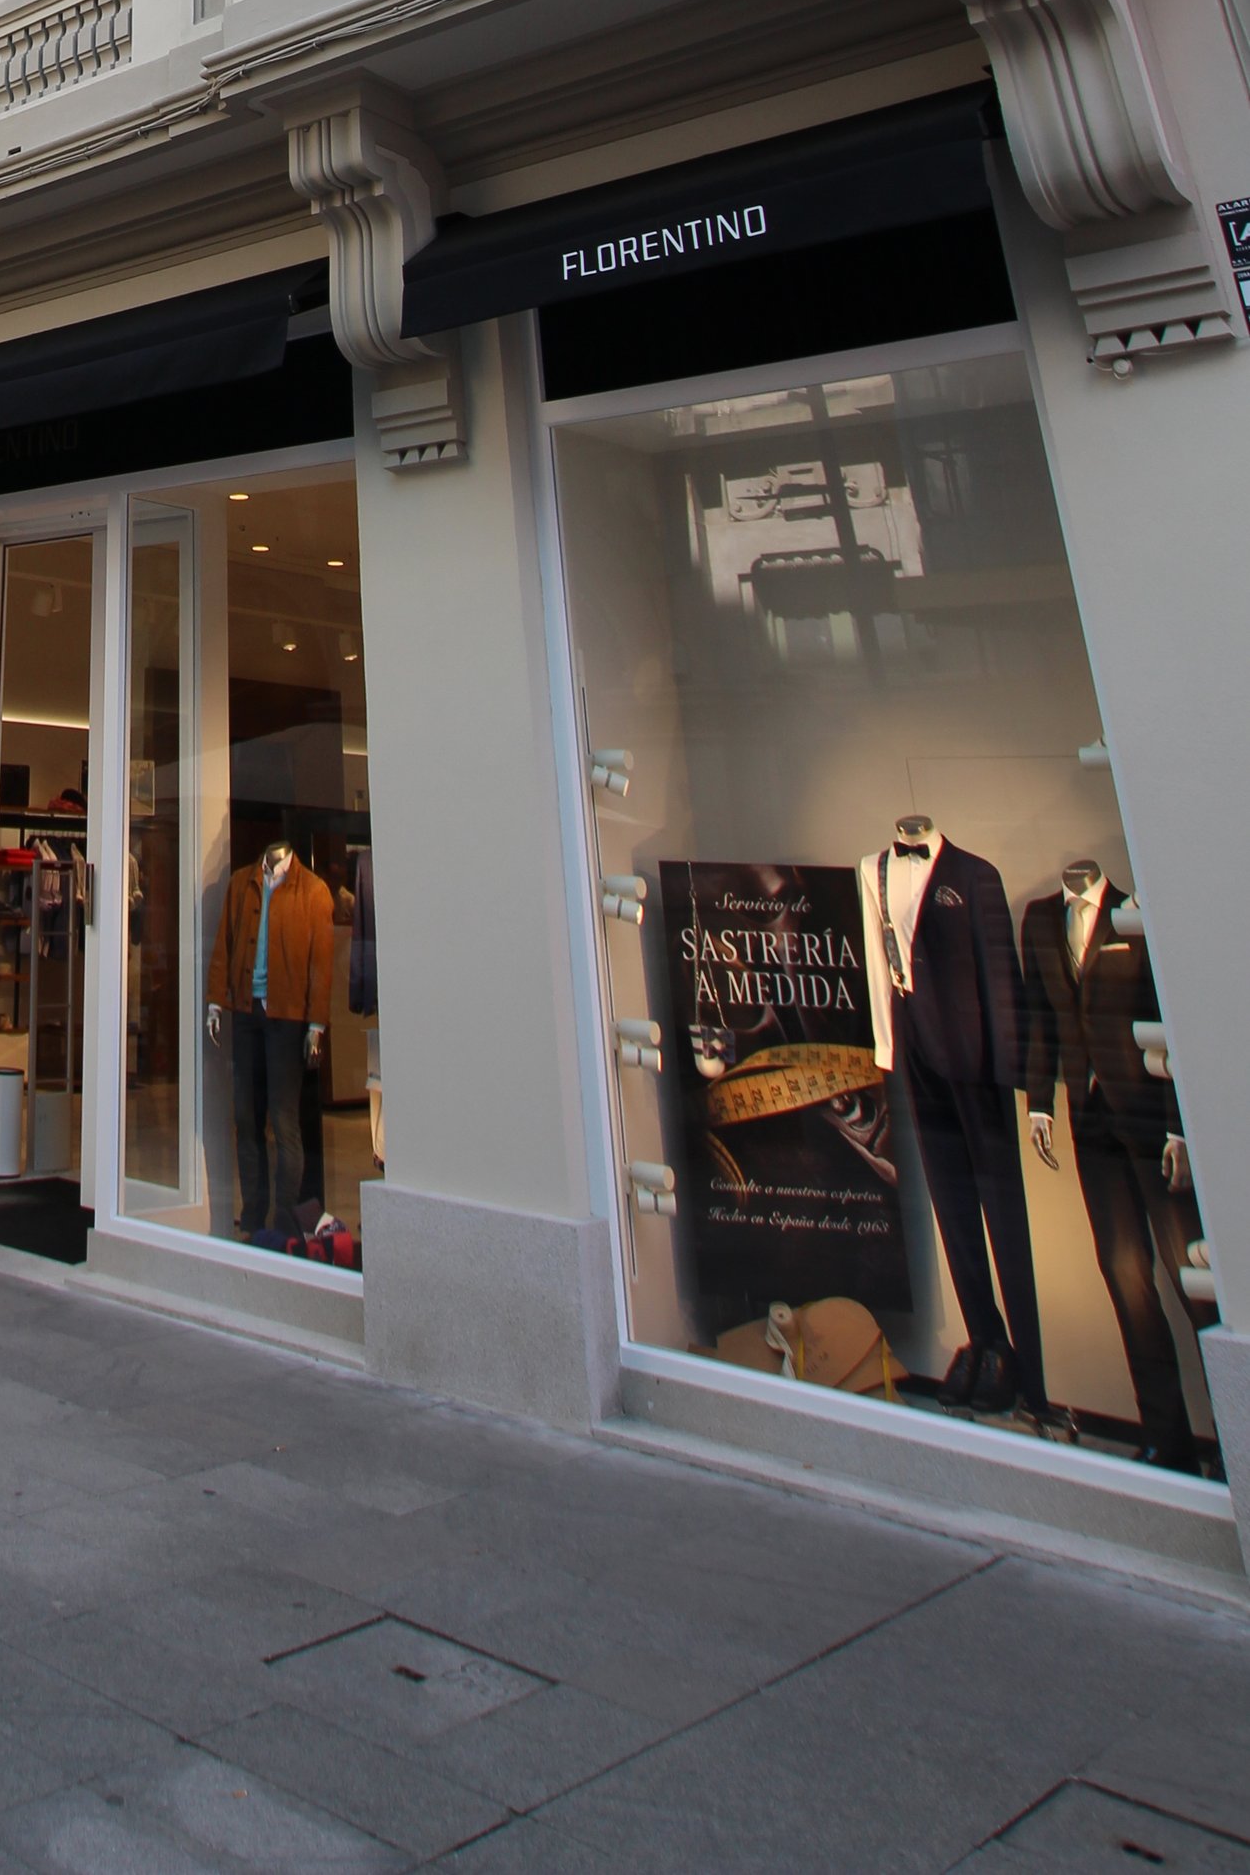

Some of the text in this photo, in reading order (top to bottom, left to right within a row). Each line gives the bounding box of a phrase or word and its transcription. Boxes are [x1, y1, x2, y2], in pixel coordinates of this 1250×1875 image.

[1219, 199, 1250, 211] ALAR
[563, 205, 767, 281] FLORENTINO
[715, 892, 812, 913] Servicio de
[681, 927, 859, 968] SASTRERÍA
[696, 970, 855, 1010] A MEDIDA
[710, 1177, 884, 1204] Consulte a nuestros expertos
[708, 1207, 747, 1223] Hecho
[750, 1214, 764, 1224] en
[768, 1211, 814, 1231] España
[817, 1215, 850, 1231] desde
